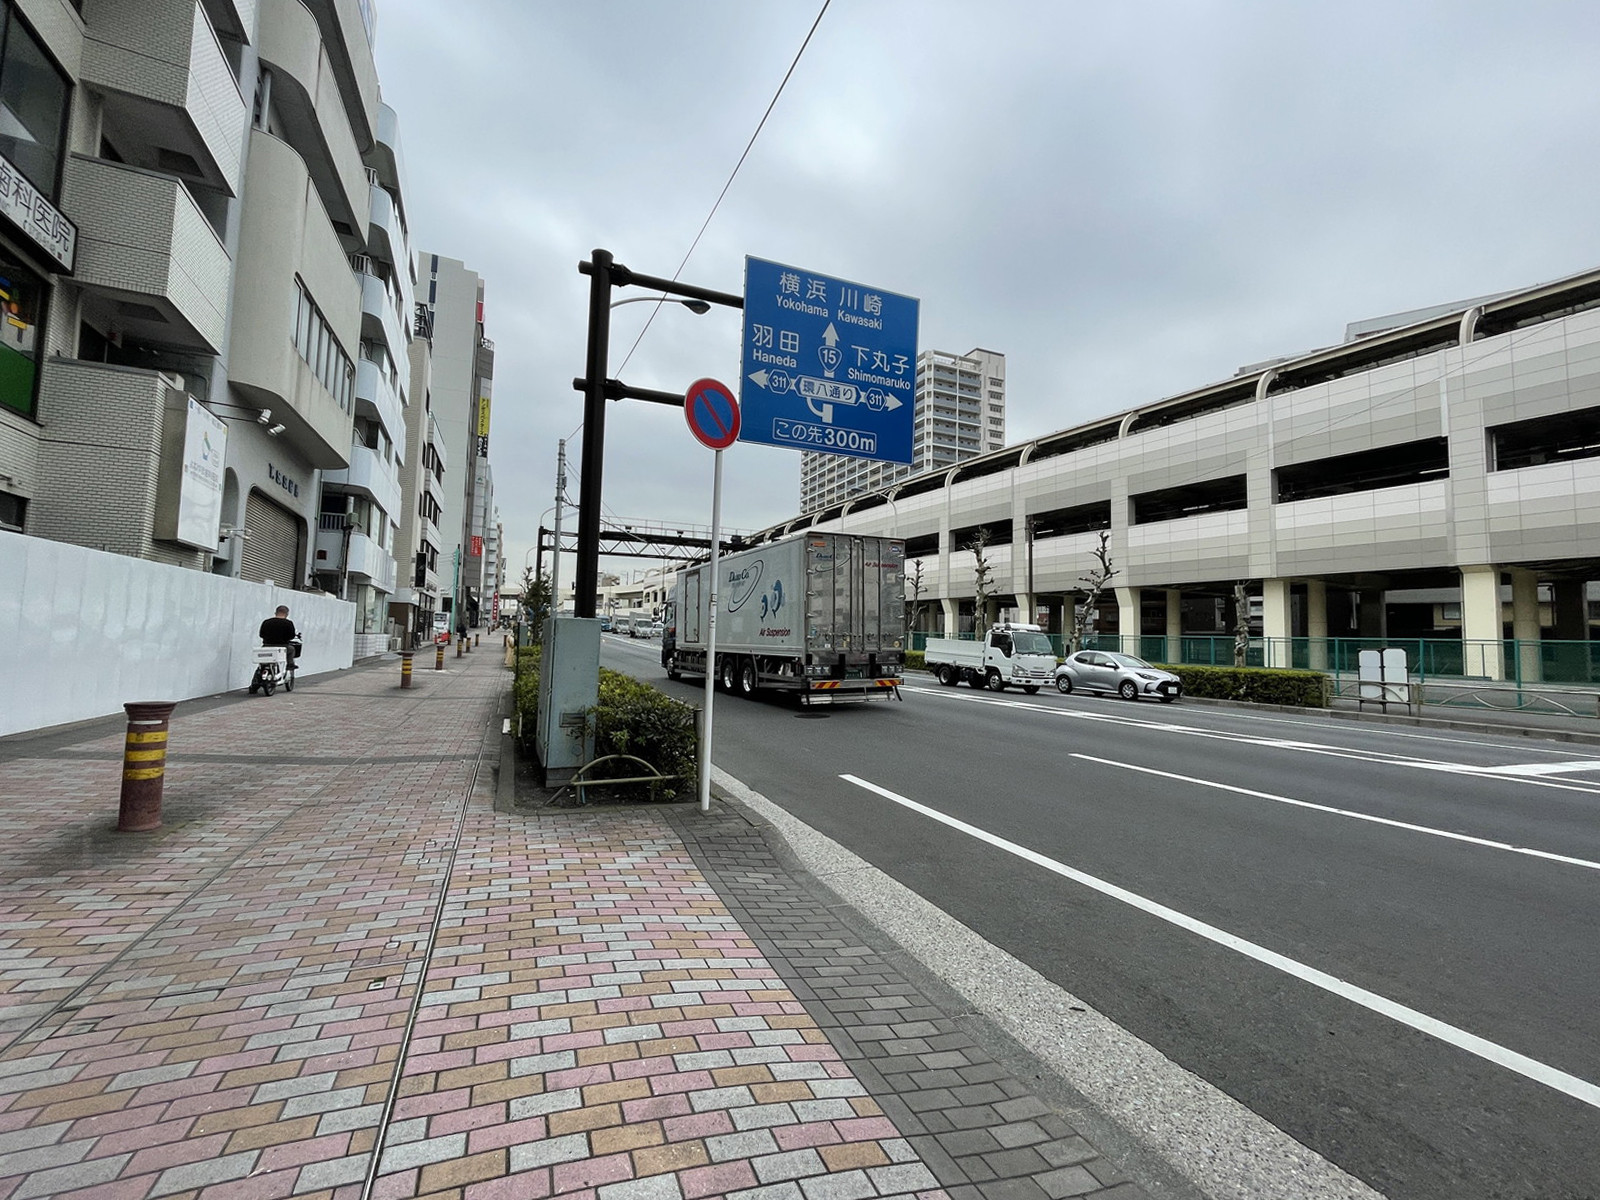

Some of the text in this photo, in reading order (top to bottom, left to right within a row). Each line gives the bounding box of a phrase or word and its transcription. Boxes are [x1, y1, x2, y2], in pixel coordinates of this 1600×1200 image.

[779, 272, 883, 316] 横浜 川崎
[776, 294, 883, 330] Yokohama Kawasaki
[752, 323, 800, 353] 羽田
[752, 348, 797, 368] Haneda
[822, 349, 837, 365] 15
[851, 344, 910, 374] 下丸子
[772, 375, 787, 389] 311
[802, 379, 854, 400] 環八通り
[847, 367, 911, 390] Shimomaruko
[868, 393, 882, 406] 311
